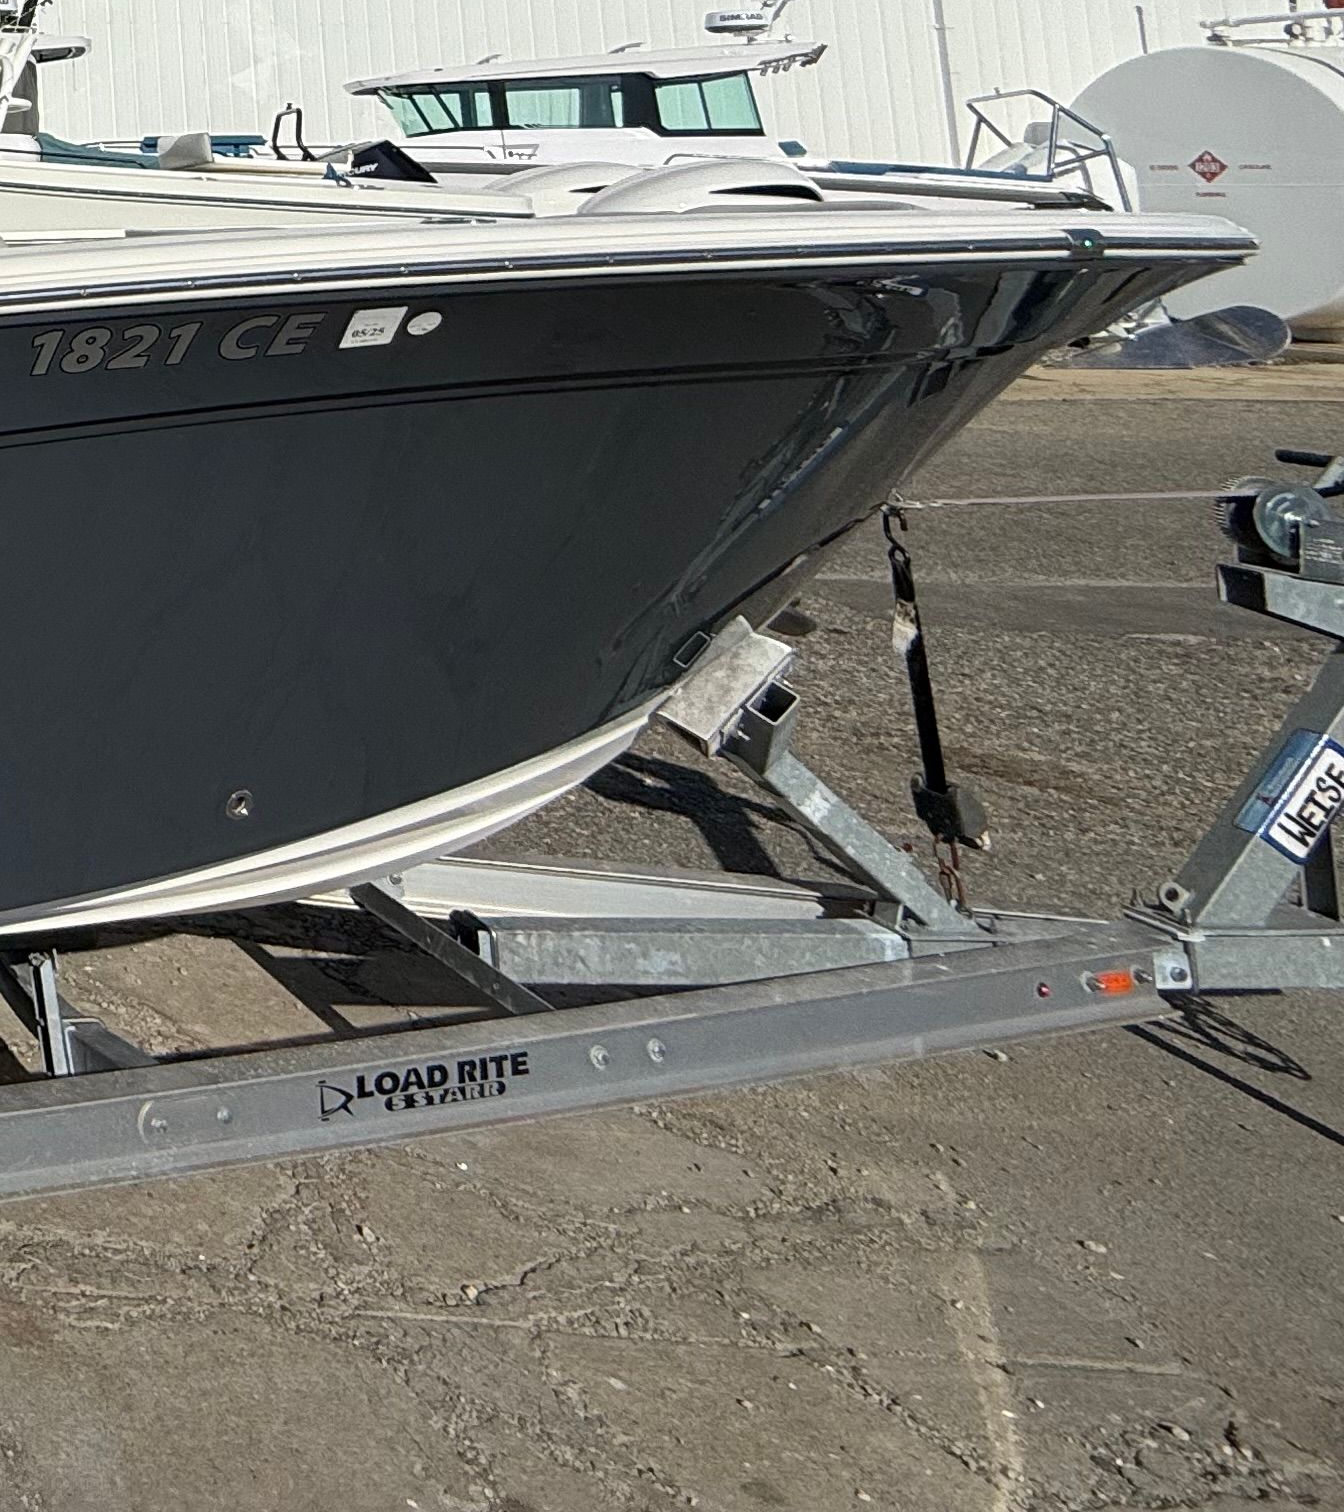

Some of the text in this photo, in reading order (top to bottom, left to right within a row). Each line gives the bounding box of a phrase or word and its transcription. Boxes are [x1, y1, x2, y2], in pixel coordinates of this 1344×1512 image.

[30, 321, 203, 377] 1821
[218, 312, 328, 361] CE
[356, 1051, 529, 1099] LOAD RITE
